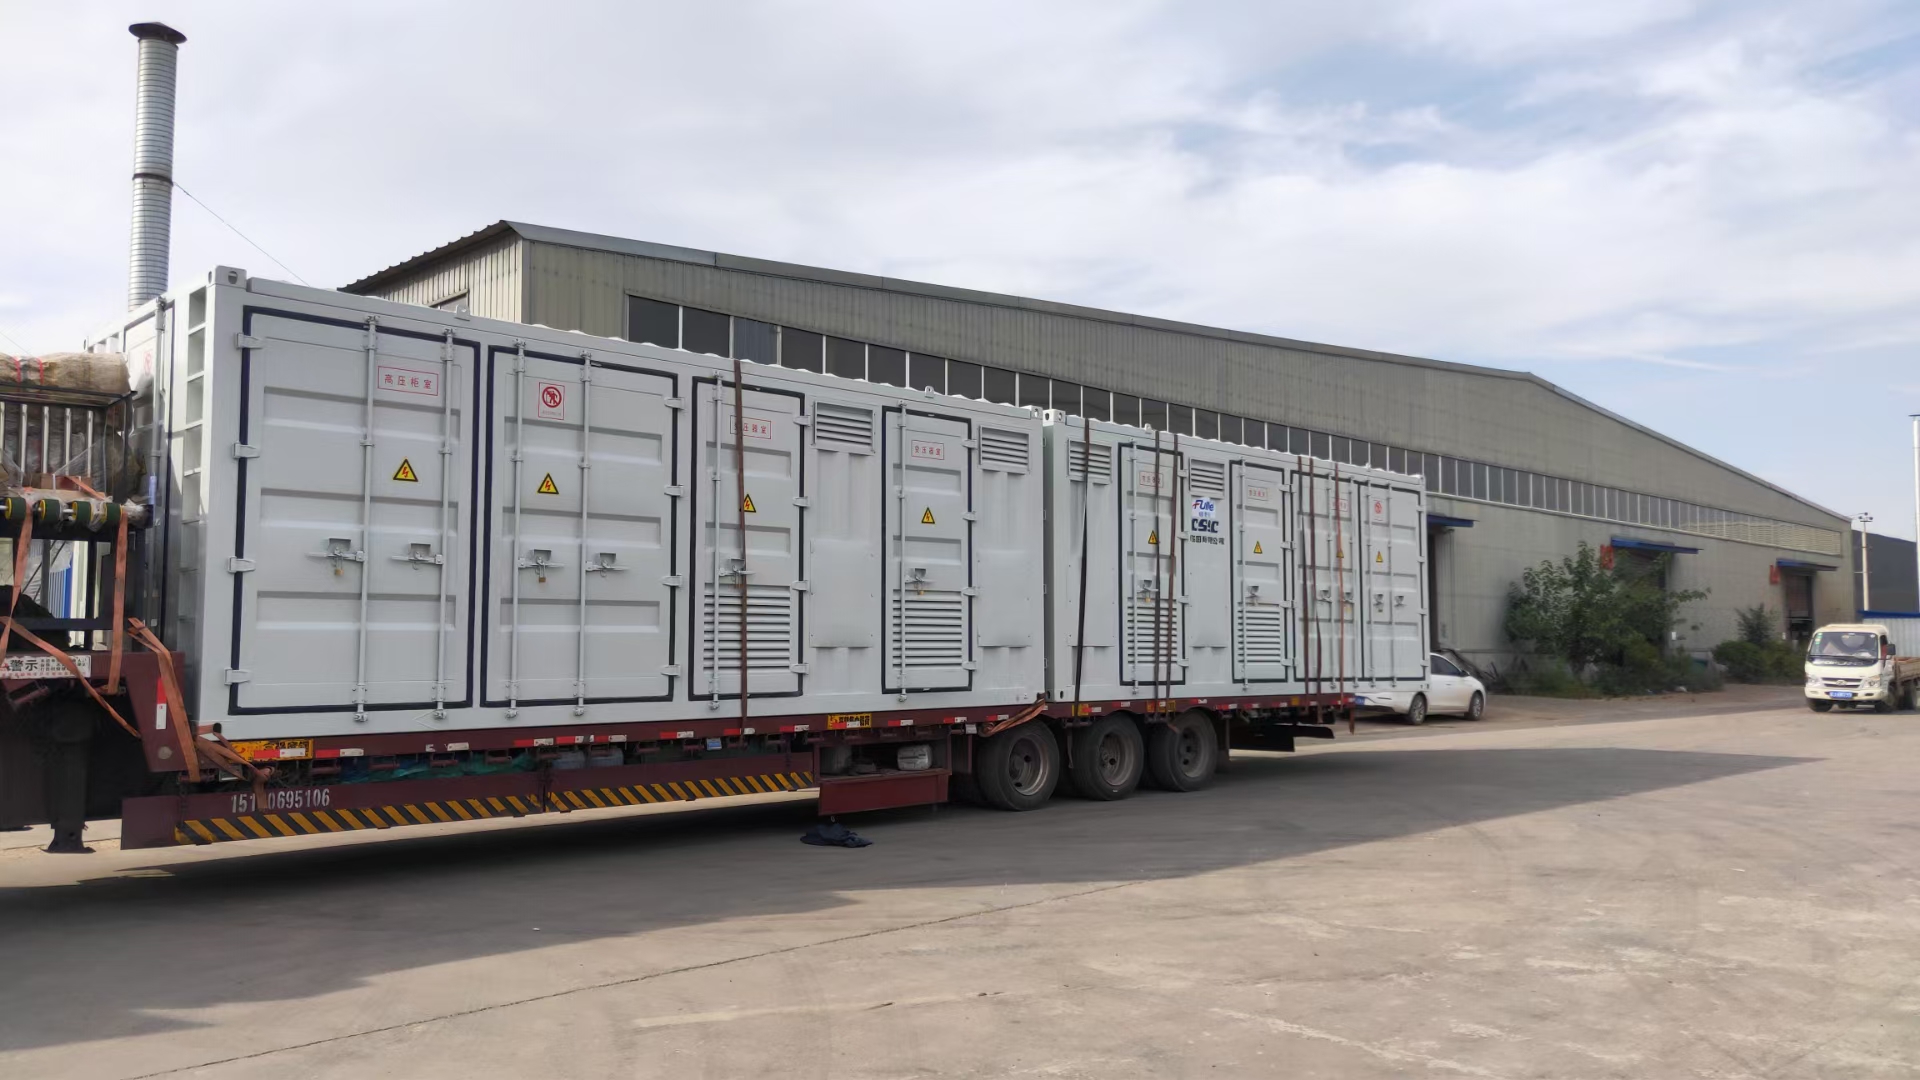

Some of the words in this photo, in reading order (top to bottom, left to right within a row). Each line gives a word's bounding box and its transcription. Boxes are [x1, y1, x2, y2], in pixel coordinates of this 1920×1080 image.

[384, 373, 432, 390] 高压柜室
[734, 421, 767, 434] 压器室
[1191, 518, 1219, 534] CSIC
[11, 659, 38, 672] 警示
[231, 788, 330, 813] 1510695106
